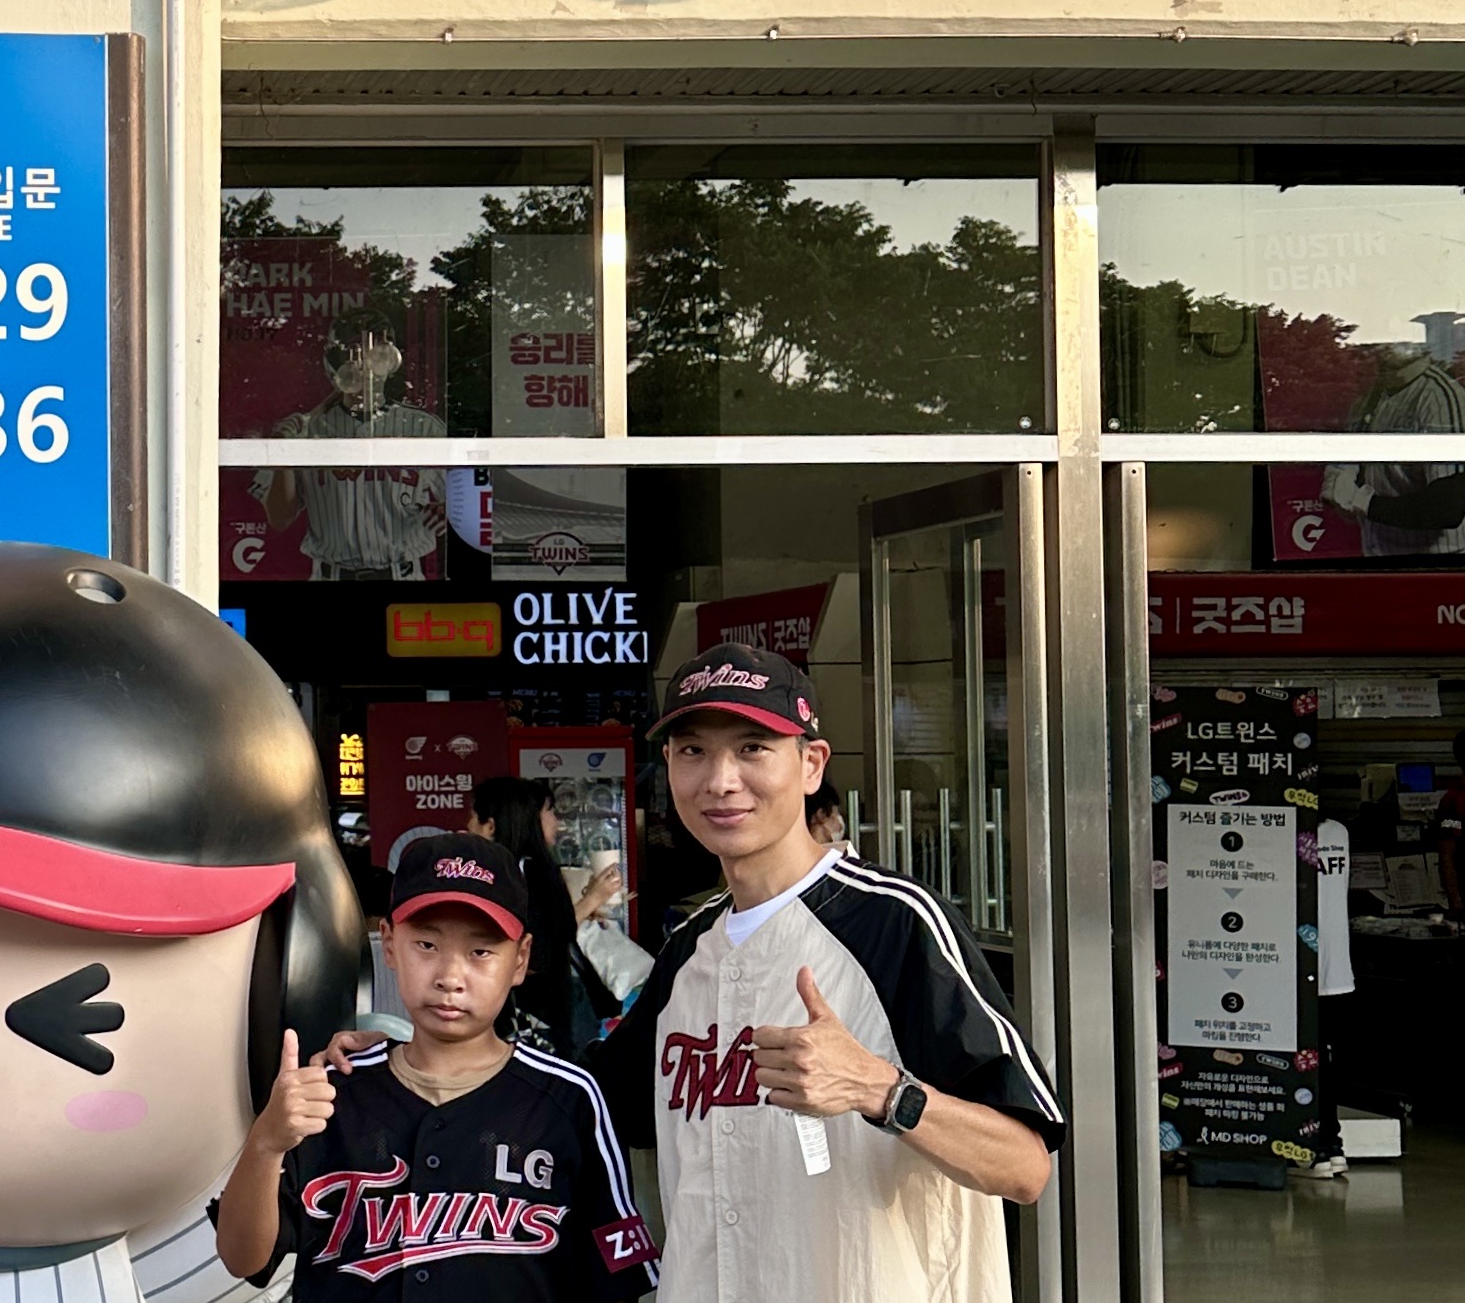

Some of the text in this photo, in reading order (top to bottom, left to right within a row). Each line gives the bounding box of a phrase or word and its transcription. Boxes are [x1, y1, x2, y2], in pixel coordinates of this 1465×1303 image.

[1263, 231, 1388, 260] AUSTIN
[1266, 263, 1358, 292] DEAN
[226, 292, 293, 318] HAE
[530, 547, 589, 561] TWINS
[513, 586, 638, 626] OLIVE
[1191, 596, 1306, 634] 굿즈샵
[1186, 721, 1278, 744] LG트윈스
[1170, 750, 1239, 776] 커스텀
[1247, 751, 1293, 777] 패치
[415, 794, 465, 810] ZONE
[1179, 810, 1216, 825] 커스텀
[1260, 813, 1286, 827] 방법
[1228, 835, 1235, 848] 1
[1227, 915, 1237, 928] 2
[1227, 996, 1238, 1009] 3
[1211, 1131, 1268, 1145] MD SHOP
[495, 1144, 555, 1190] LG
